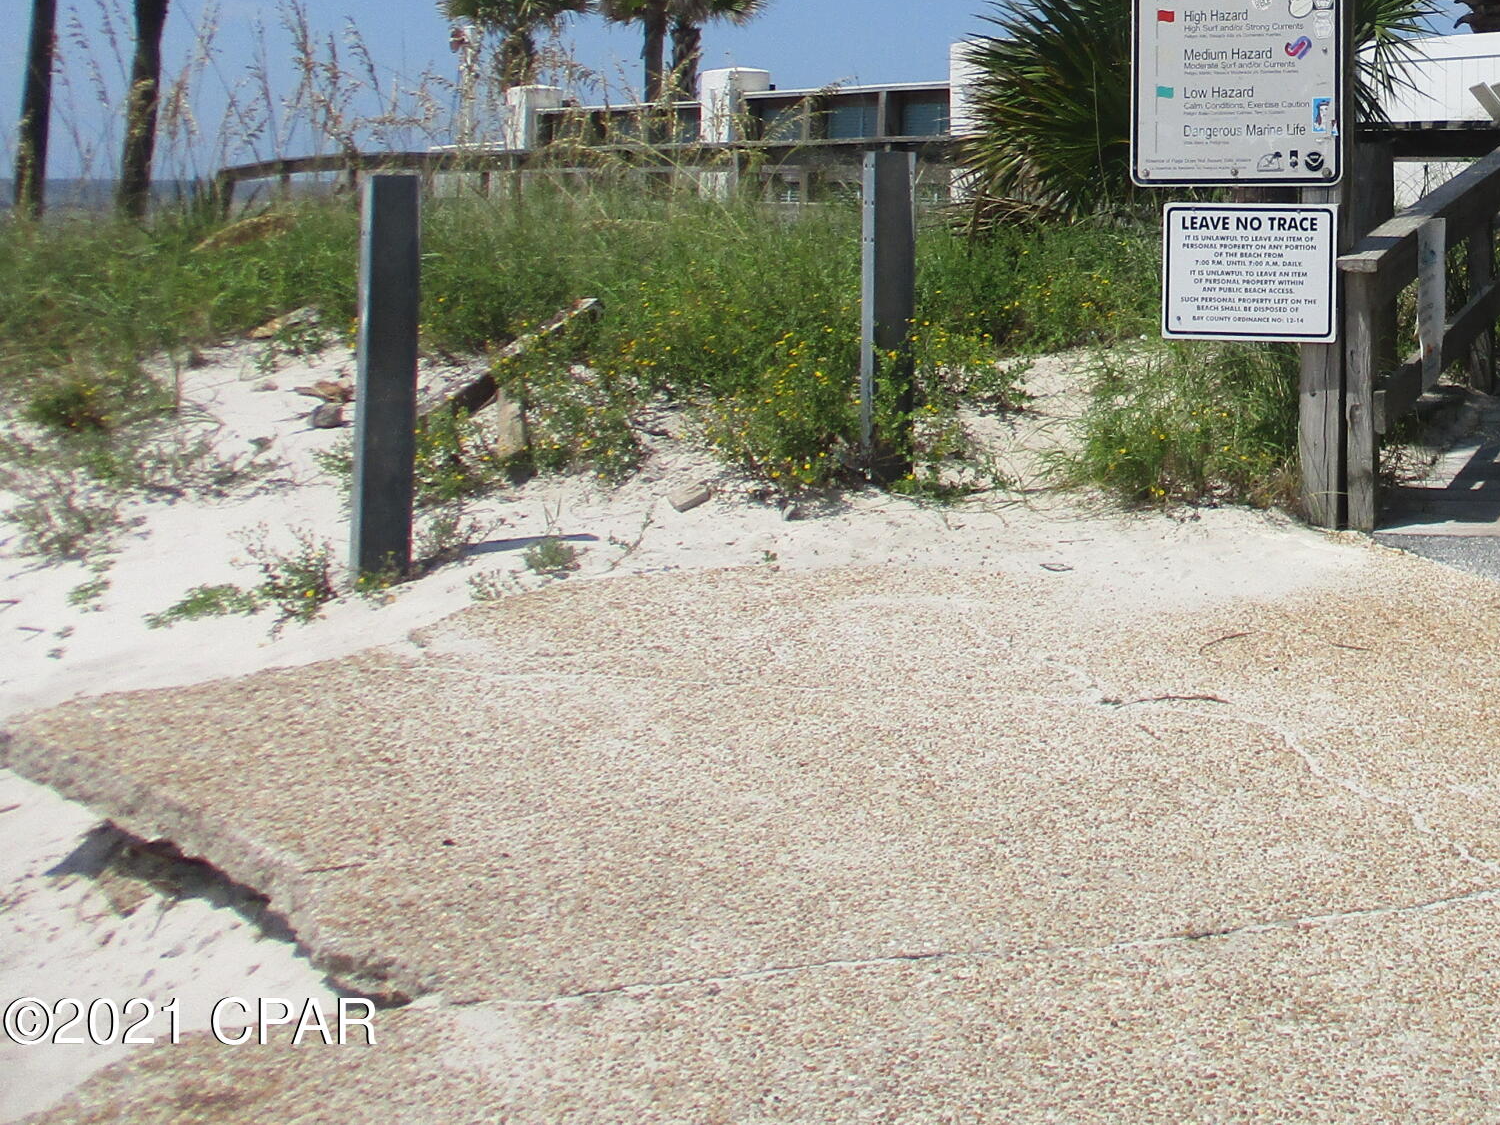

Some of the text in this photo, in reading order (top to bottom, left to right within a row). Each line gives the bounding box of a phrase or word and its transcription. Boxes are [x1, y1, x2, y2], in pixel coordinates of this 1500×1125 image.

[1184, 9, 1248, 25] High Hazard
[1184, 25, 1200, 34] High
[1202, 24, 1218, 32] Surf
[1246, 23, 1270, 32] Strong
[1271, 22, 1304, 30] Currents
[1184, 47, 1273, 61] Medium Hazard
[1184, 62, 1219, 70] Moderate
[1263, 60, 1296, 69] Currents
[1183, 86, 1254, 99] Low Hazard
[1281, 100, 1310, 108] Caution
[1183, 123, 1306, 140] Dangerous Marine Life
[1181, 216, 1318, 232] LEAVE NO TRACE
